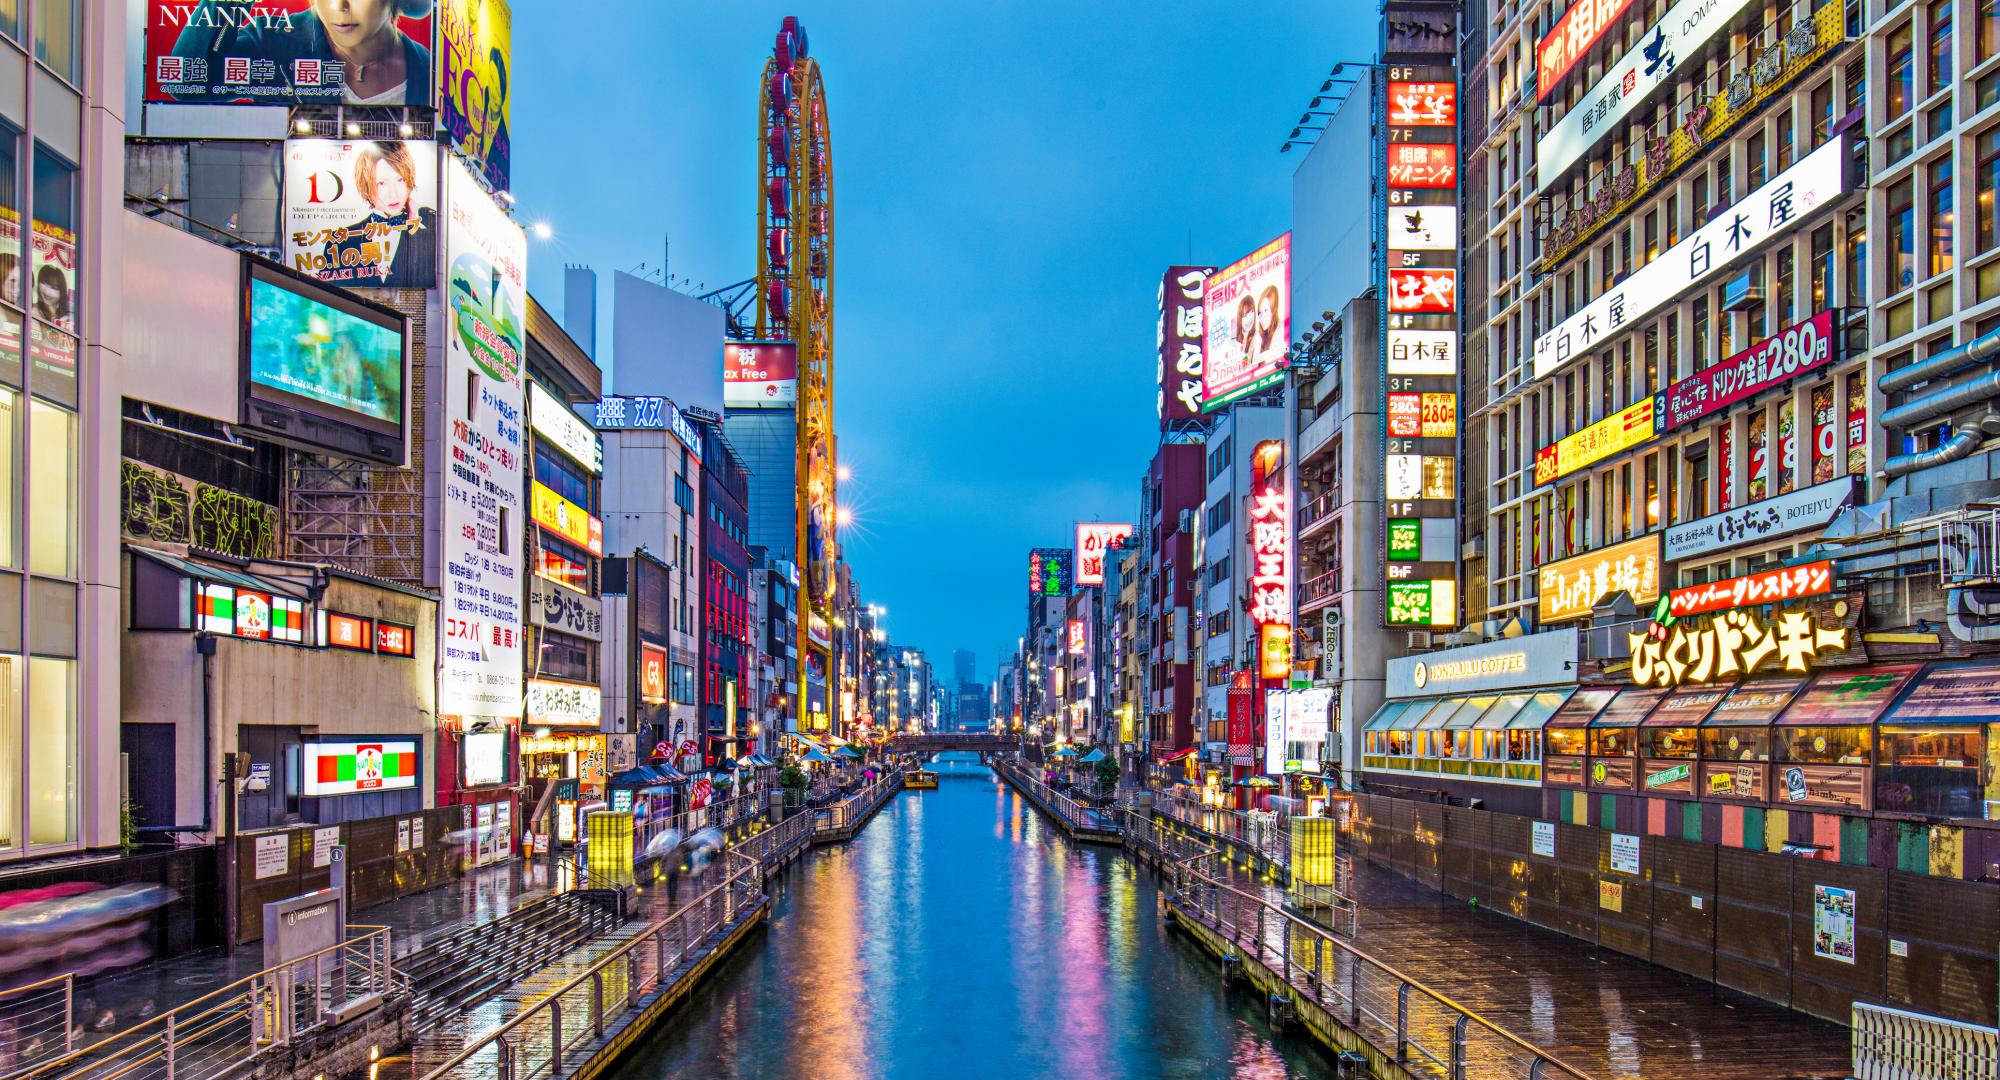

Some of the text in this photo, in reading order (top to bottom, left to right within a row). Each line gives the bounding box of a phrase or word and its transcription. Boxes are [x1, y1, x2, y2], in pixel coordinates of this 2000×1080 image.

[159, 5, 294, 29] NYANNYA
[158, 56, 345, 85] 最強 最幸 最高
[1390, 67, 1413, 80] 8F
[1582, 83, 1621, 137] 居酒家
[1391, 129, 1413, 142] 7F
[1399, 147, 1428, 164] 相席
[1390, 164, 1455, 184] ダイニング
[1390, 190, 1413, 204] 6F
[292, 216, 422, 247] モンスターグループ
[1690, 181, 1797, 280] 白木屋
[1402, 253, 1421, 266] 5F
[357, 265, 392, 278] RUKA
[1210, 273, 1251, 312] 高収入
[1390, 315, 1414, 328] 4F
[1538, 292, 1627, 363] 4F 白木屋
[738, 348, 757, 366] 税
[1392, 338, 1450, 361] 白木屋
[1712, 322, 1828, 402] ドリンク全品280円
[724, 368, 768, 379] ax Free
[1391, 378, 1413, 390] 3F
[1389, 401, 1420, 414] 280円
[1671, 383, 1708, 414] 居心伝
[596, 396, 664, 427] 無双
[1423, 404, 1455, 423] 280円
[1655, 395, 1666, 431] 3階
[1390, 440, 1413, 453] 2F
[1391, 503, 1413, 516] 1F
[1787, 498, 1833, 520] BOTEJYU
[1668, 524, 1714, 547] 大阪 お好み焼
[1250, 487, 1285, 625] 大阪王将
[1389, 566, 1412, 578] B1F
[1542, 569, 1558, 588] 2F
[1552, 555, 1639, 614] 山内農場
[1671, 567, 1829, 610] ハンバーグレストラン
[544, 588, 586, 632] うなぎ
[340, 622, 353, 642] 酒
[377, 628, 404, 648] たばこ
[447, 618, 480, 642] コスパ
[1325, 626, 1336, 672] ZERO cafe
[1628, 610, 1846, 687] びっくりドンキー
[647, 660, 659, 685] G3
[1429, 655, 1524, 681] HONOLULU COFFEE
[656, 741, 674, 757] G3
[682, 741, 699, 754] G3
[1738, 767, 1752, 777] KEEP
[1735, 784, 1752, 795] RIGHT
[297, 906, 328, 921] information
